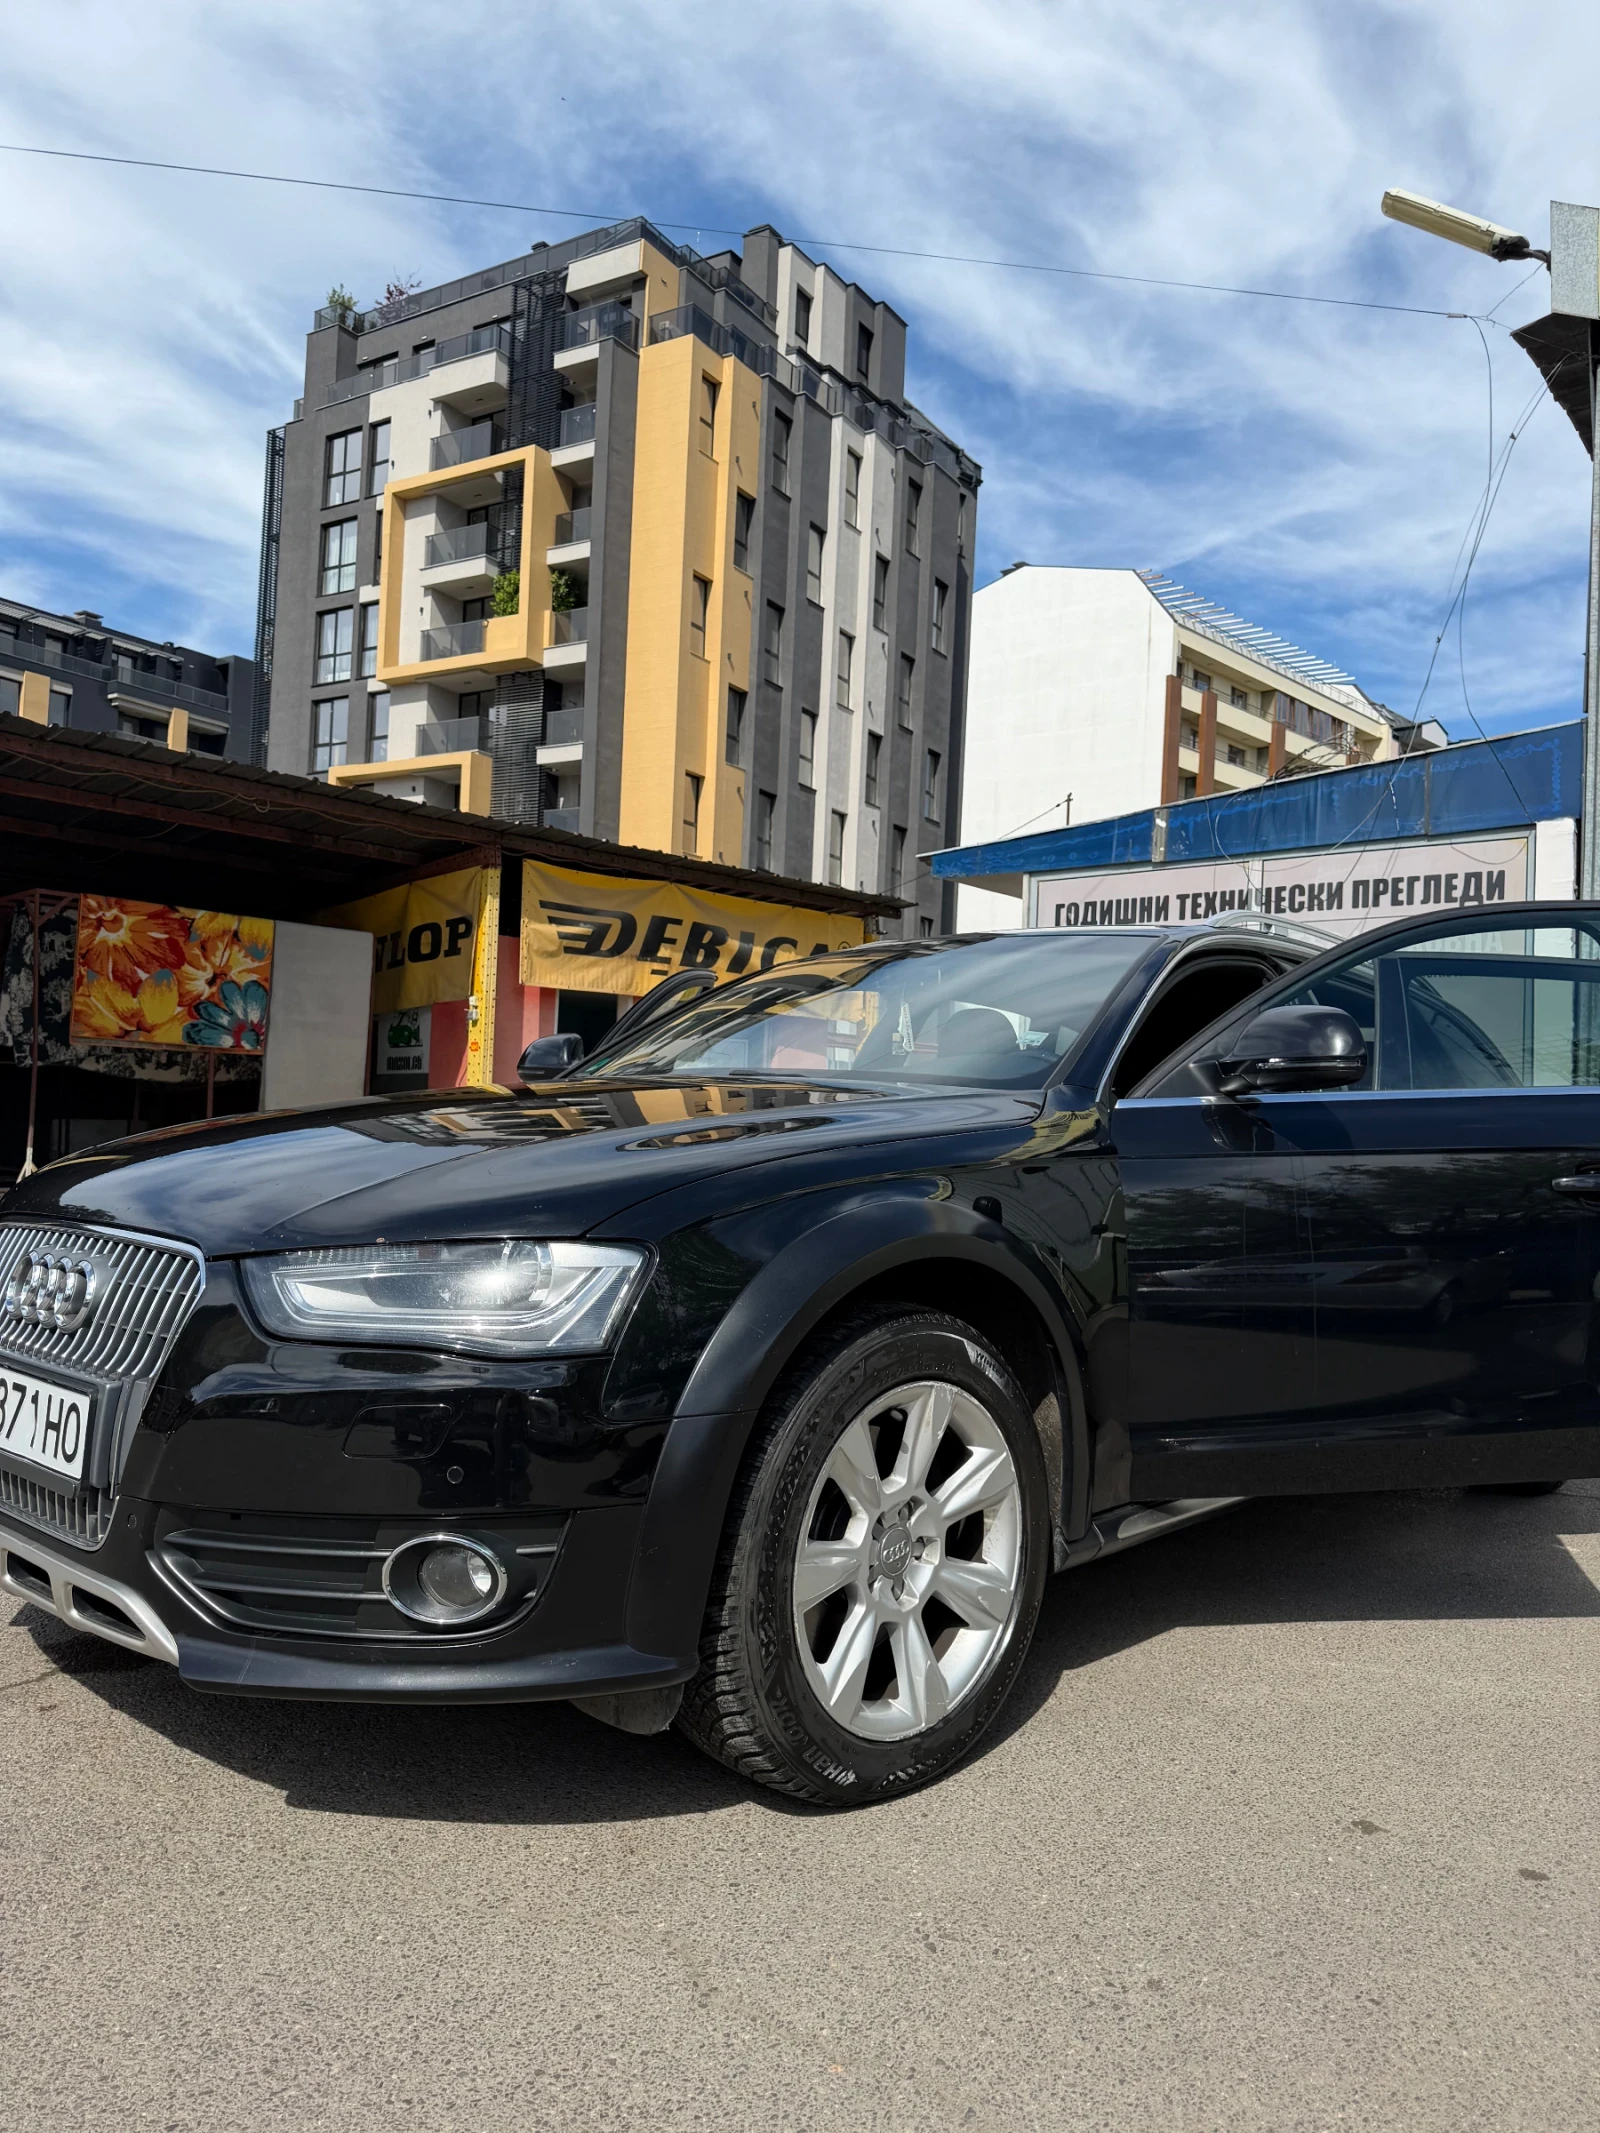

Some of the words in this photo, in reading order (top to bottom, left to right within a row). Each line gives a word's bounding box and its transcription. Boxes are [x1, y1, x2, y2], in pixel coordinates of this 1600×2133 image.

[1055, 895, 1170, 926] ГОДИШНИ
[1176, 881, 1344, 921] ТЕХНИЧЕСКИ
[1352, 870, 1505, 909] ПРЕГЛЕДИ
